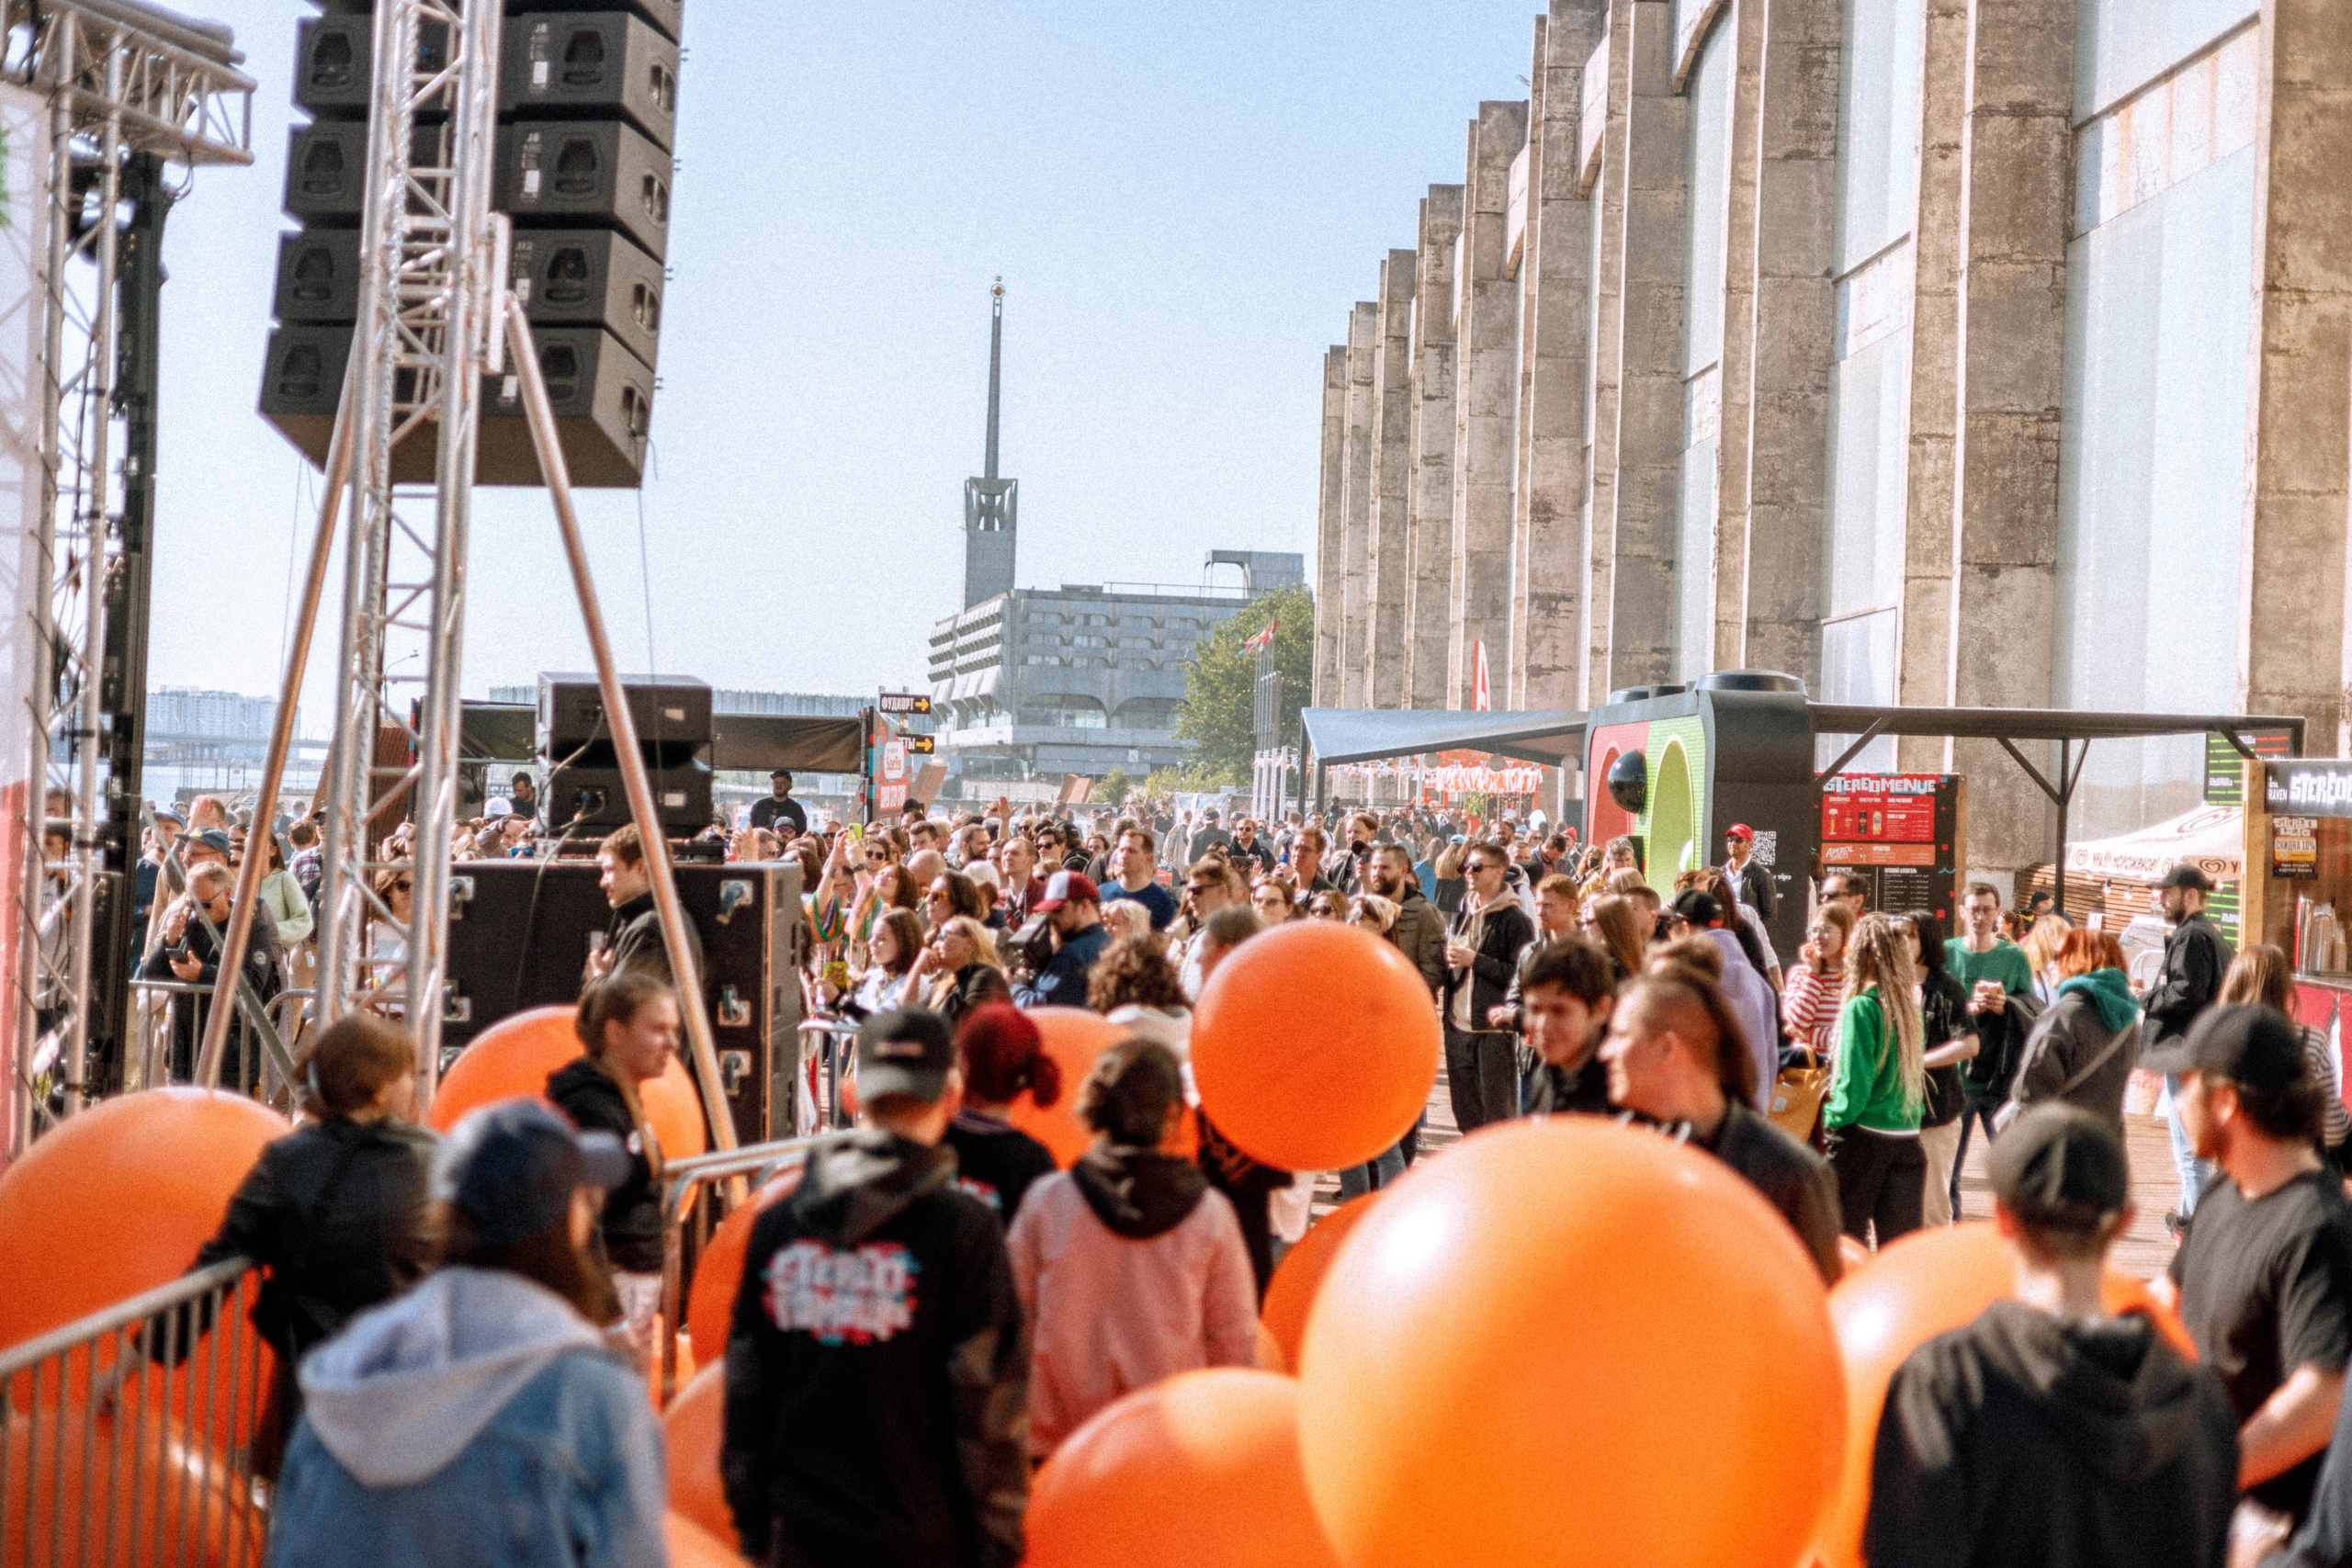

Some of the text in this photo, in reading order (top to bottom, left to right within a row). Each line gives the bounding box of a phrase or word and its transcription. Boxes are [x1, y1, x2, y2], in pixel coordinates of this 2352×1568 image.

[881, 696, 915, 712] ФУДКОРТ
[1823, 776, 1936, 795] STEREOMENUE
[1826, 845, 1854, 858] APEROL
[2276, 839, 2316, 851] СКИДКА 10%
